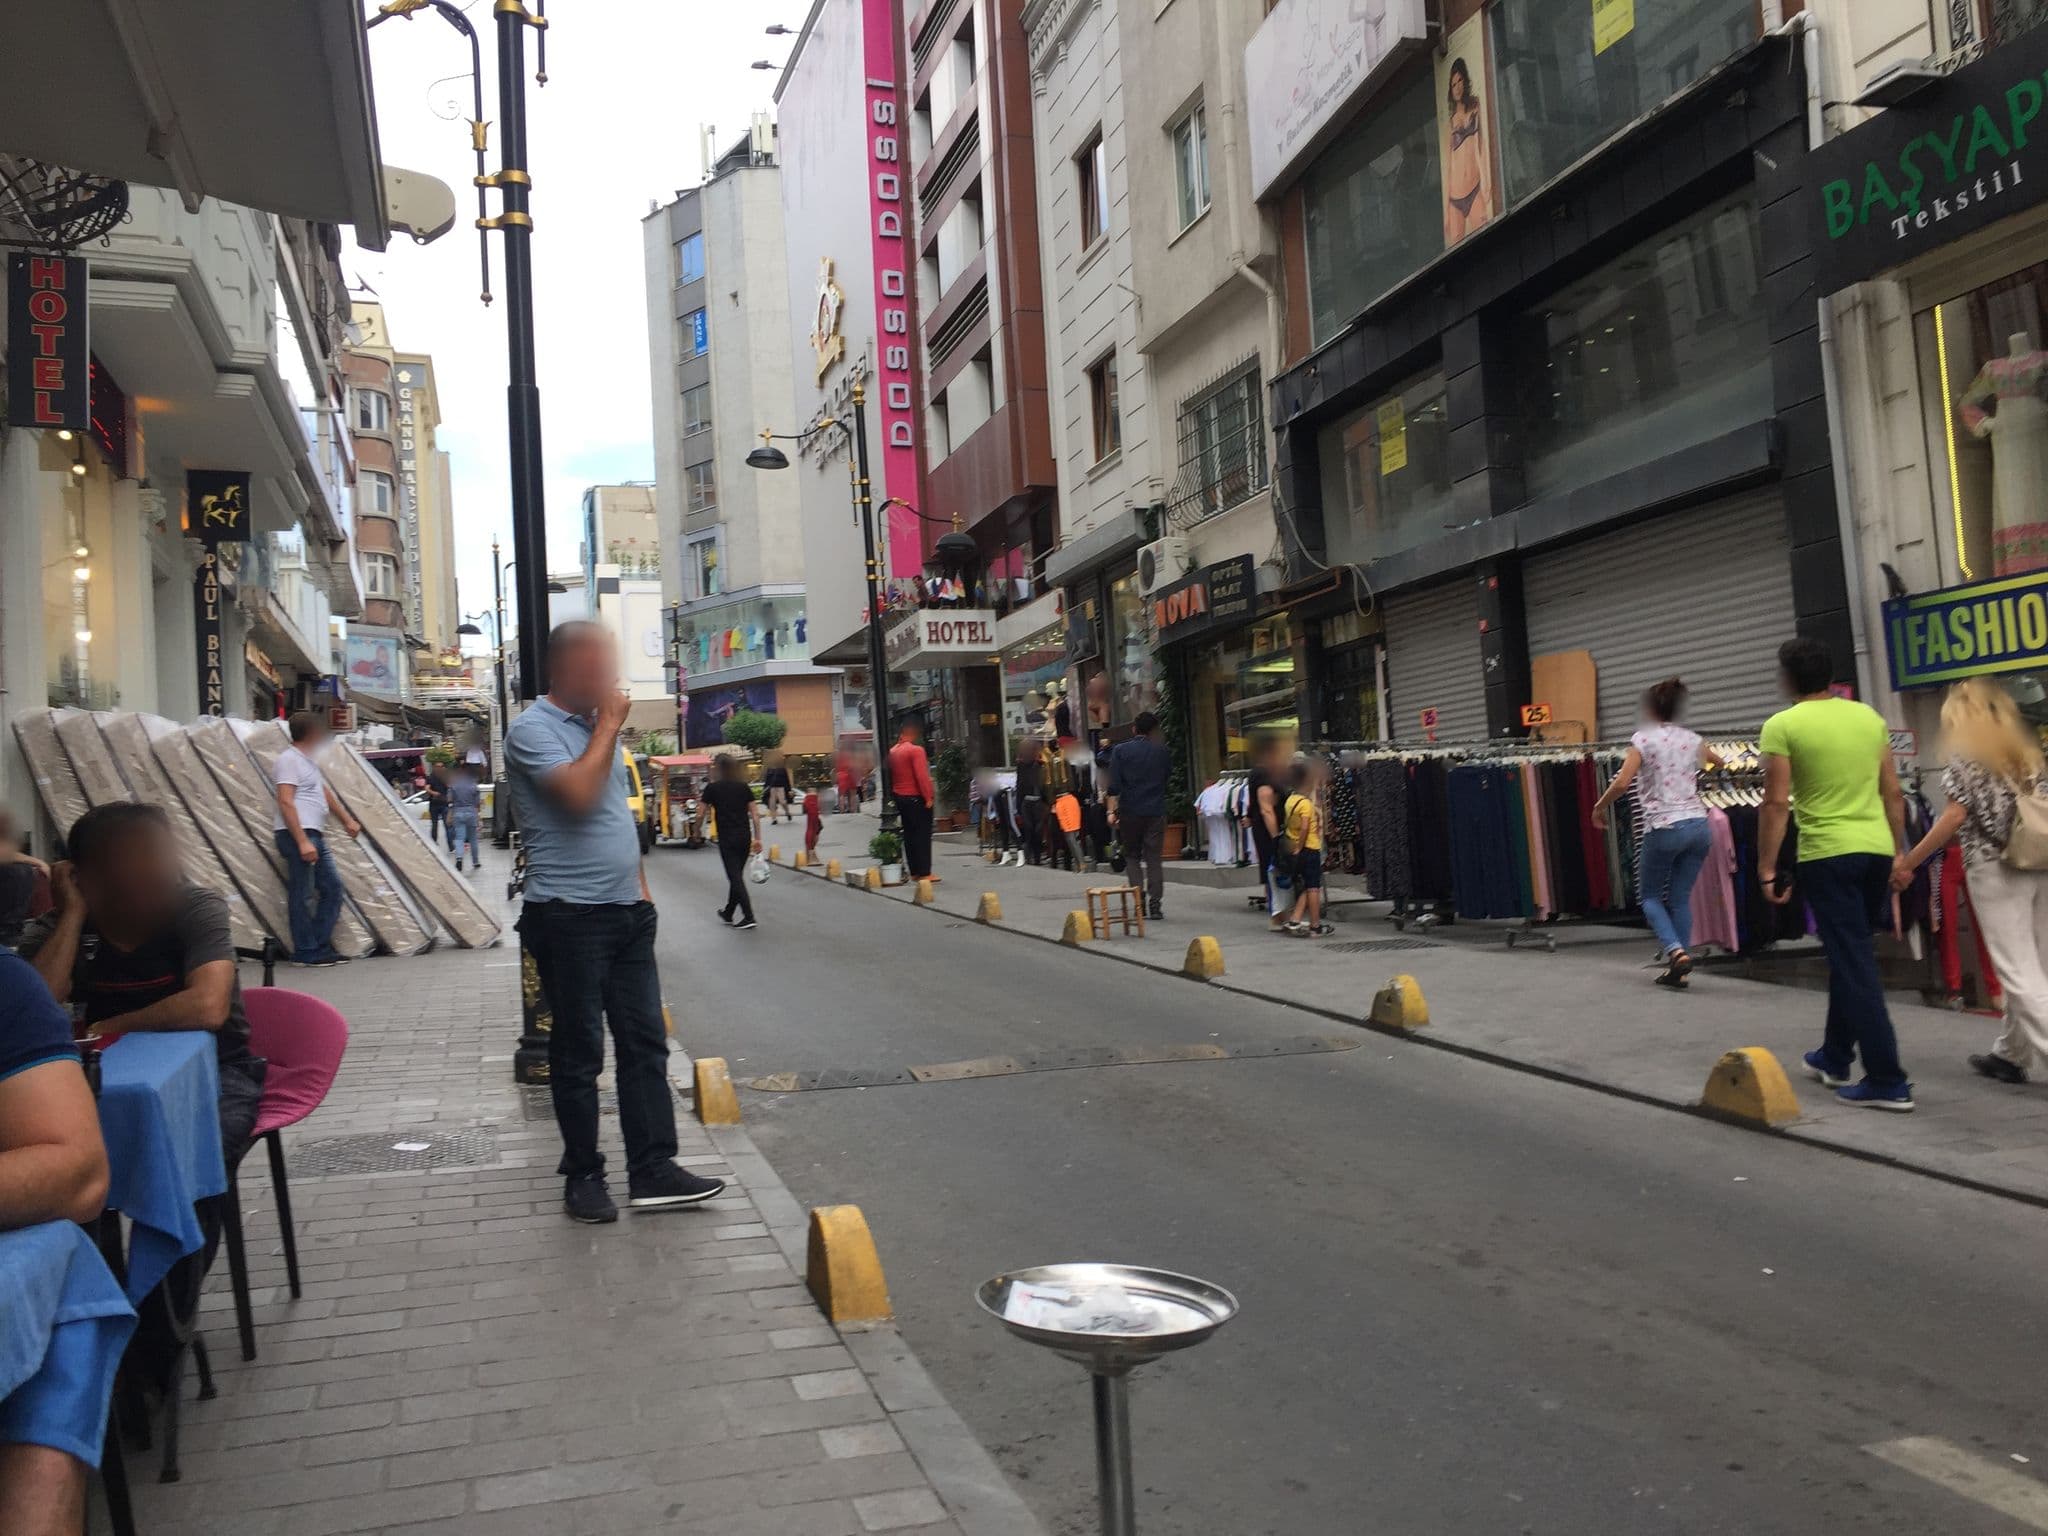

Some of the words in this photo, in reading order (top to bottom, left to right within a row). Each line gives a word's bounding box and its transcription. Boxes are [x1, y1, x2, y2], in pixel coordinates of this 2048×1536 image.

[865, 78, 902, 238] DOSSI
[1822, 68, 2048, 240] BAŞYAP
[1890, 159, 2024, 240] Tekstil
[29, 257, 68, 424] HOTEL
[881, 269, 914, 448] DOSSO
[400, 387, 414, 451] GRAND
[203, 553, 219, 621] PAUL
[1154, 583, 1209, 629] NOVA
[925, 621, 993, 645] HOTEL
[1904, 591, 2048, 668] FASHIO
